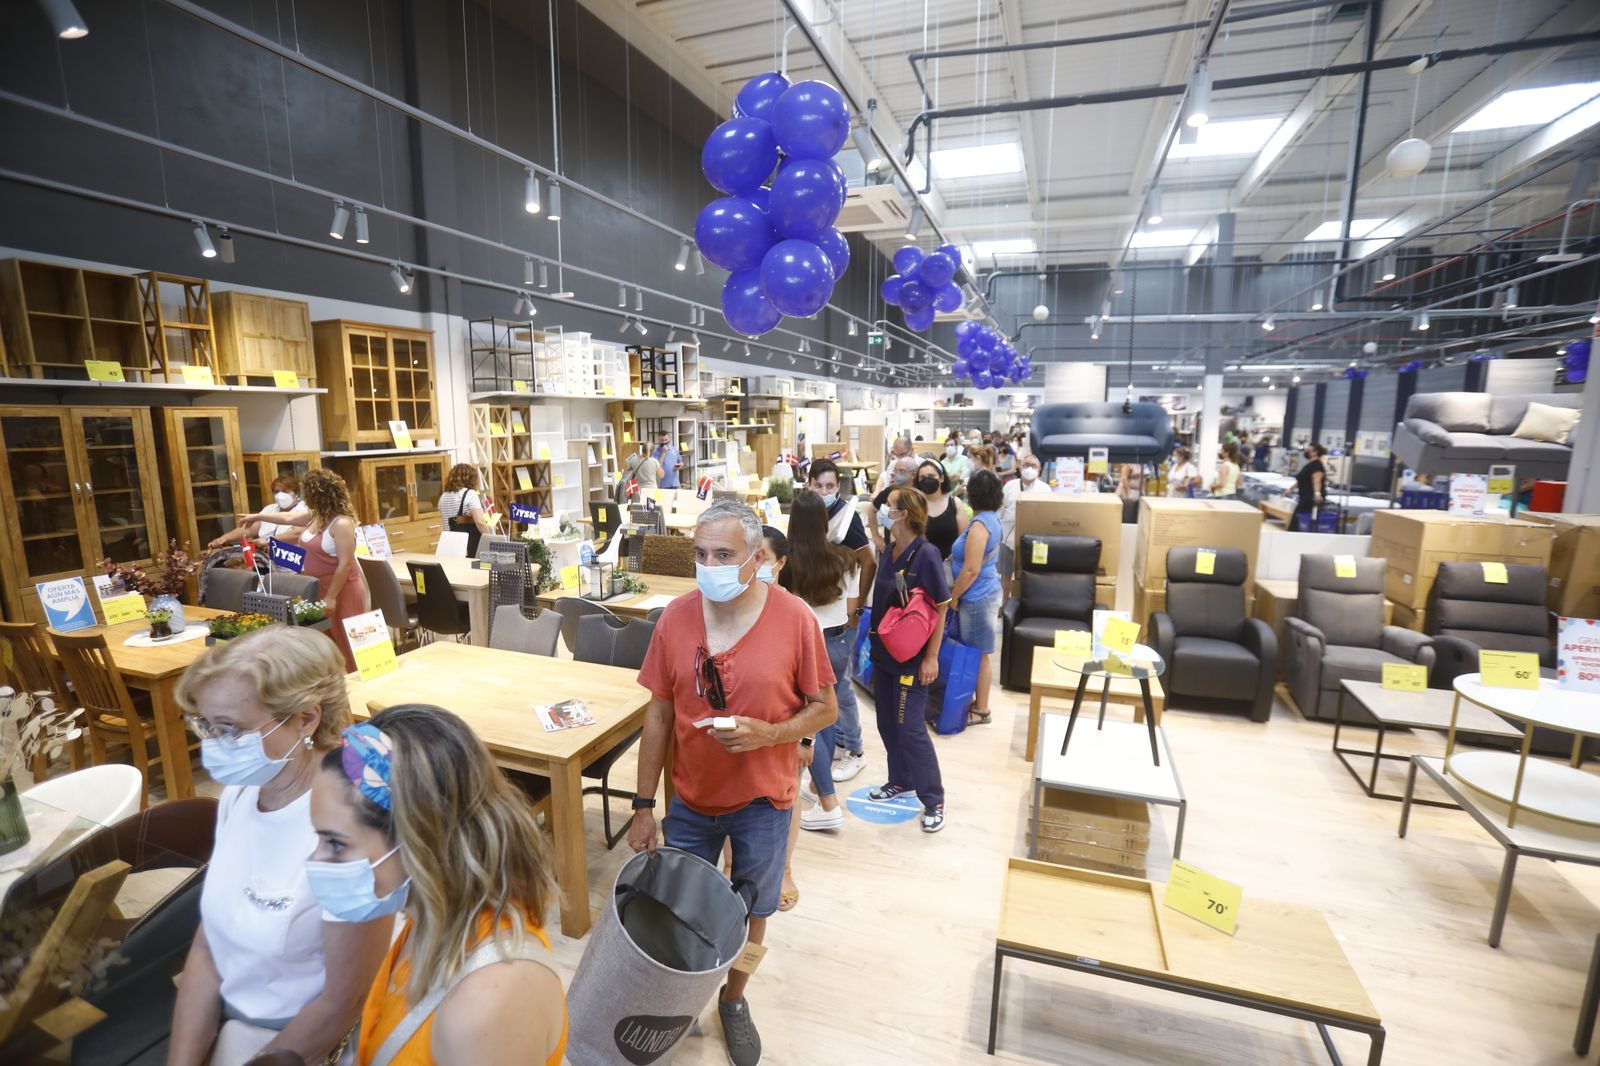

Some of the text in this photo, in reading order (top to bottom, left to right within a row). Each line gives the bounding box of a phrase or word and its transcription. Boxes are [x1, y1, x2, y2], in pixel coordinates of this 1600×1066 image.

[515, 508, 537, 520] JYSK
[275, 547, 303, 566] JYSK
[47, 583, 77, 593] OFERTA
